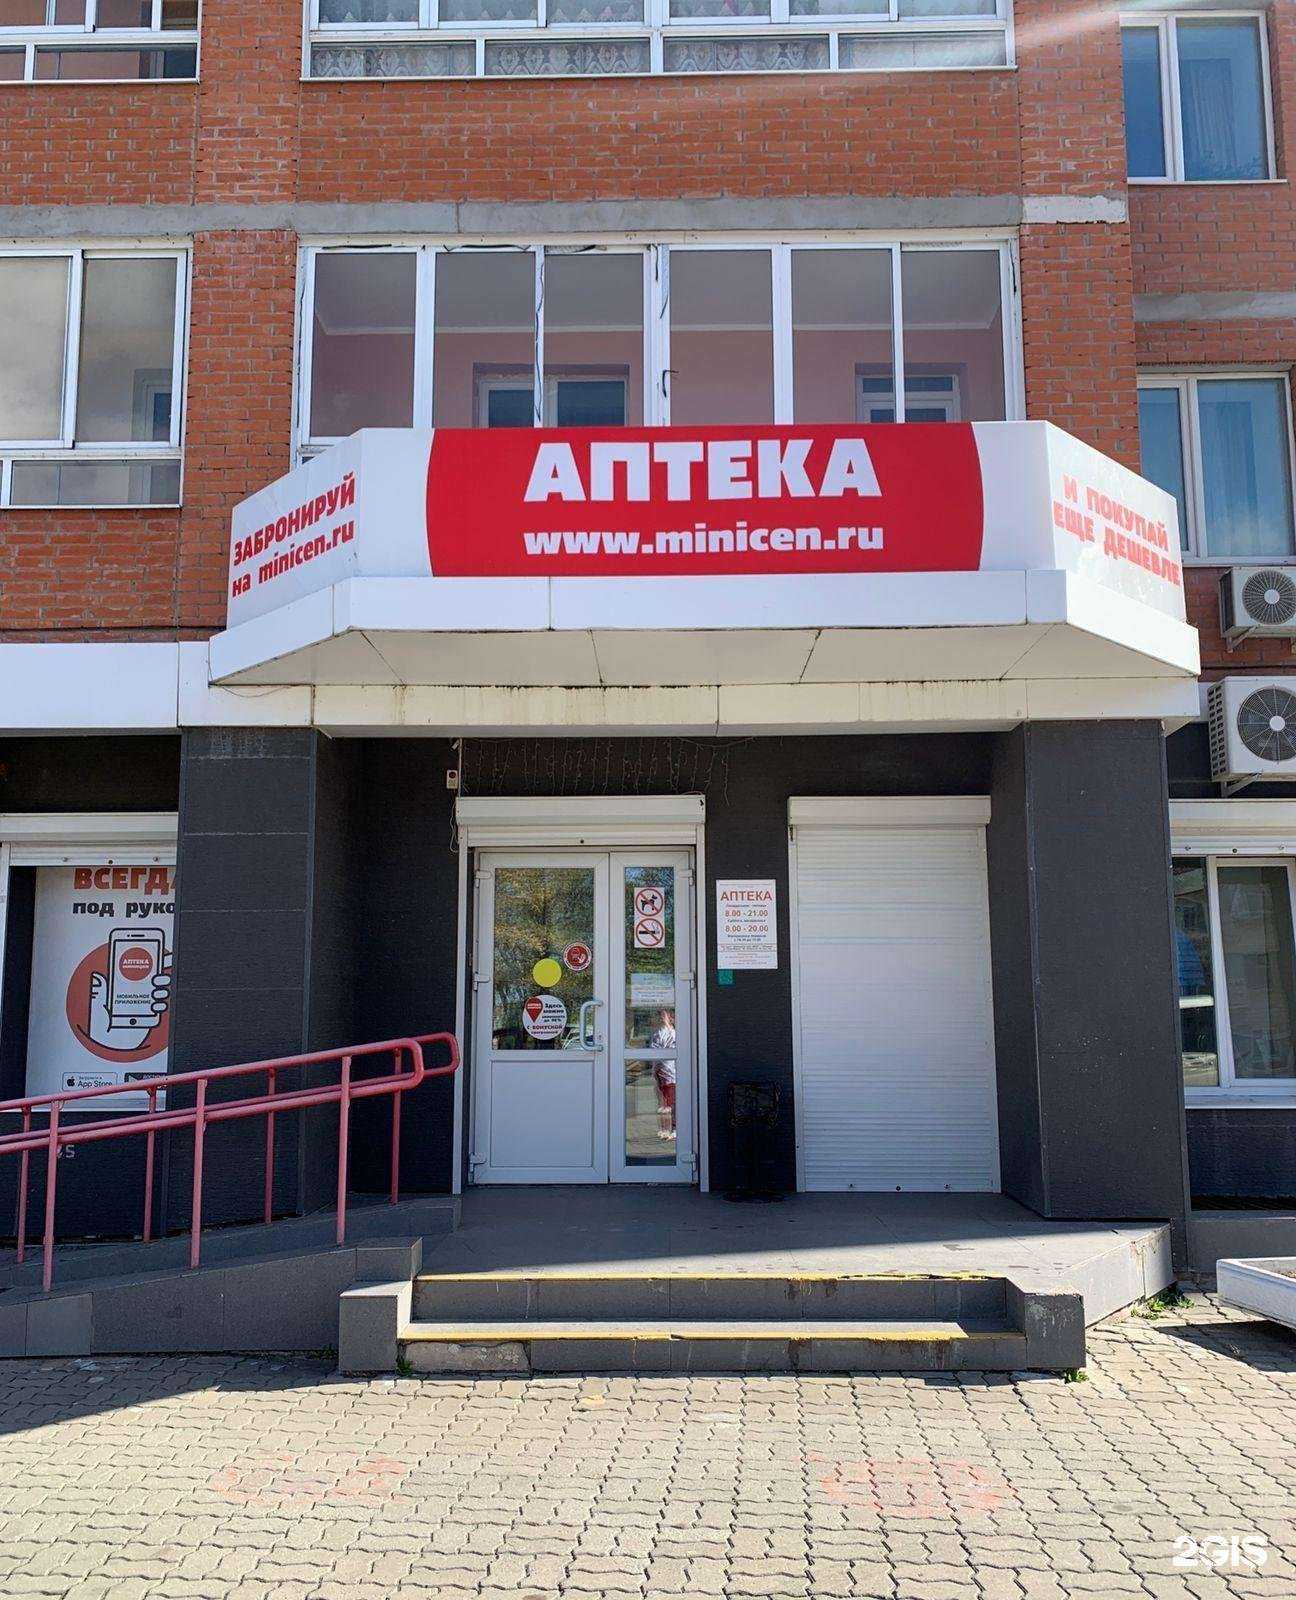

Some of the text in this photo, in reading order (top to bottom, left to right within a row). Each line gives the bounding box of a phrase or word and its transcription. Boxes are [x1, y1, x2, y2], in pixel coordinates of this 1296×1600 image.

[523, 438, 882, 502] АПТЕКА
[233, 470, 355, 566] ЗАБРОНИРУЙ
[523, 521, 884, 555] www.minicen.ru
[1052, 500, 1181, 586] ЕЩЕ ДЕШЕВЛЕ
[1062, 473, 1169, 553] И ПОКУПАЙ
[232, 520, 355, 597] на minicen.ru
[72, 902, 115, 918] под
[720, 890, 773, 901] АПТЕКА
[77, 1080, 94, 1088] App
